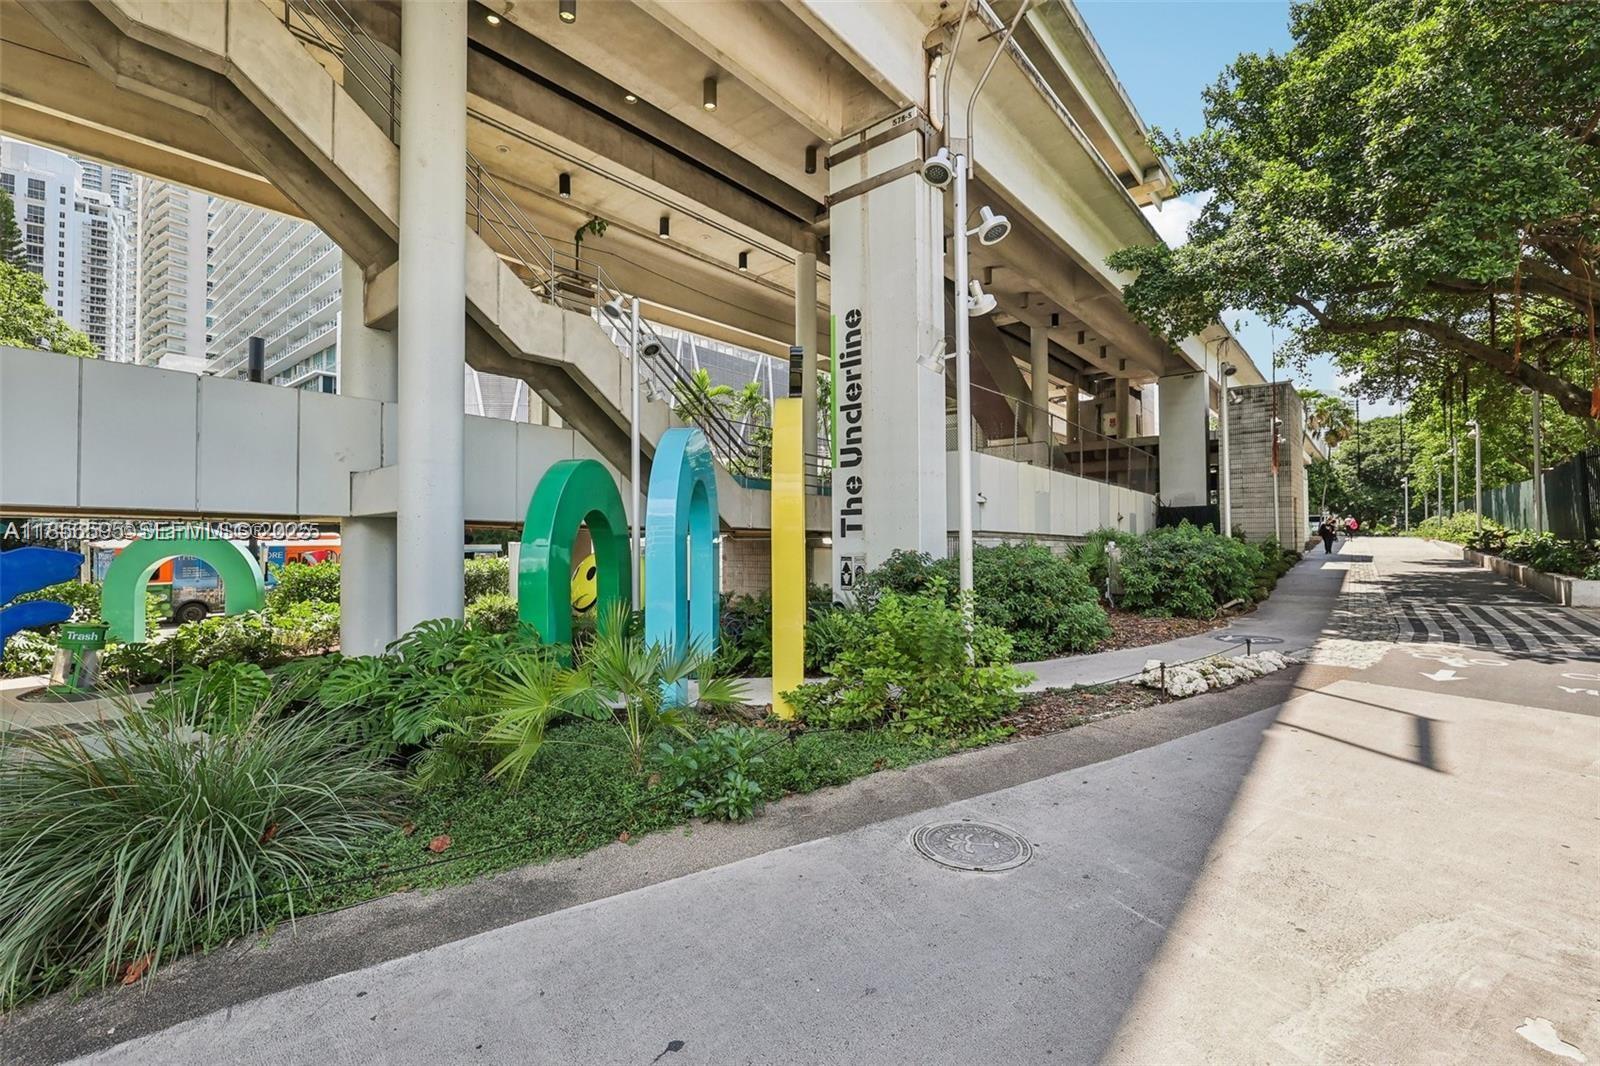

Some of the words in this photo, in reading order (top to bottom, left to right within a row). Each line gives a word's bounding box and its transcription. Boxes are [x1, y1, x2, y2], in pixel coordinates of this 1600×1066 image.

[840, 308, 862, 468] Underline
[840, 476, 862, 538] The
[67, 631, 99, 641] Trash
